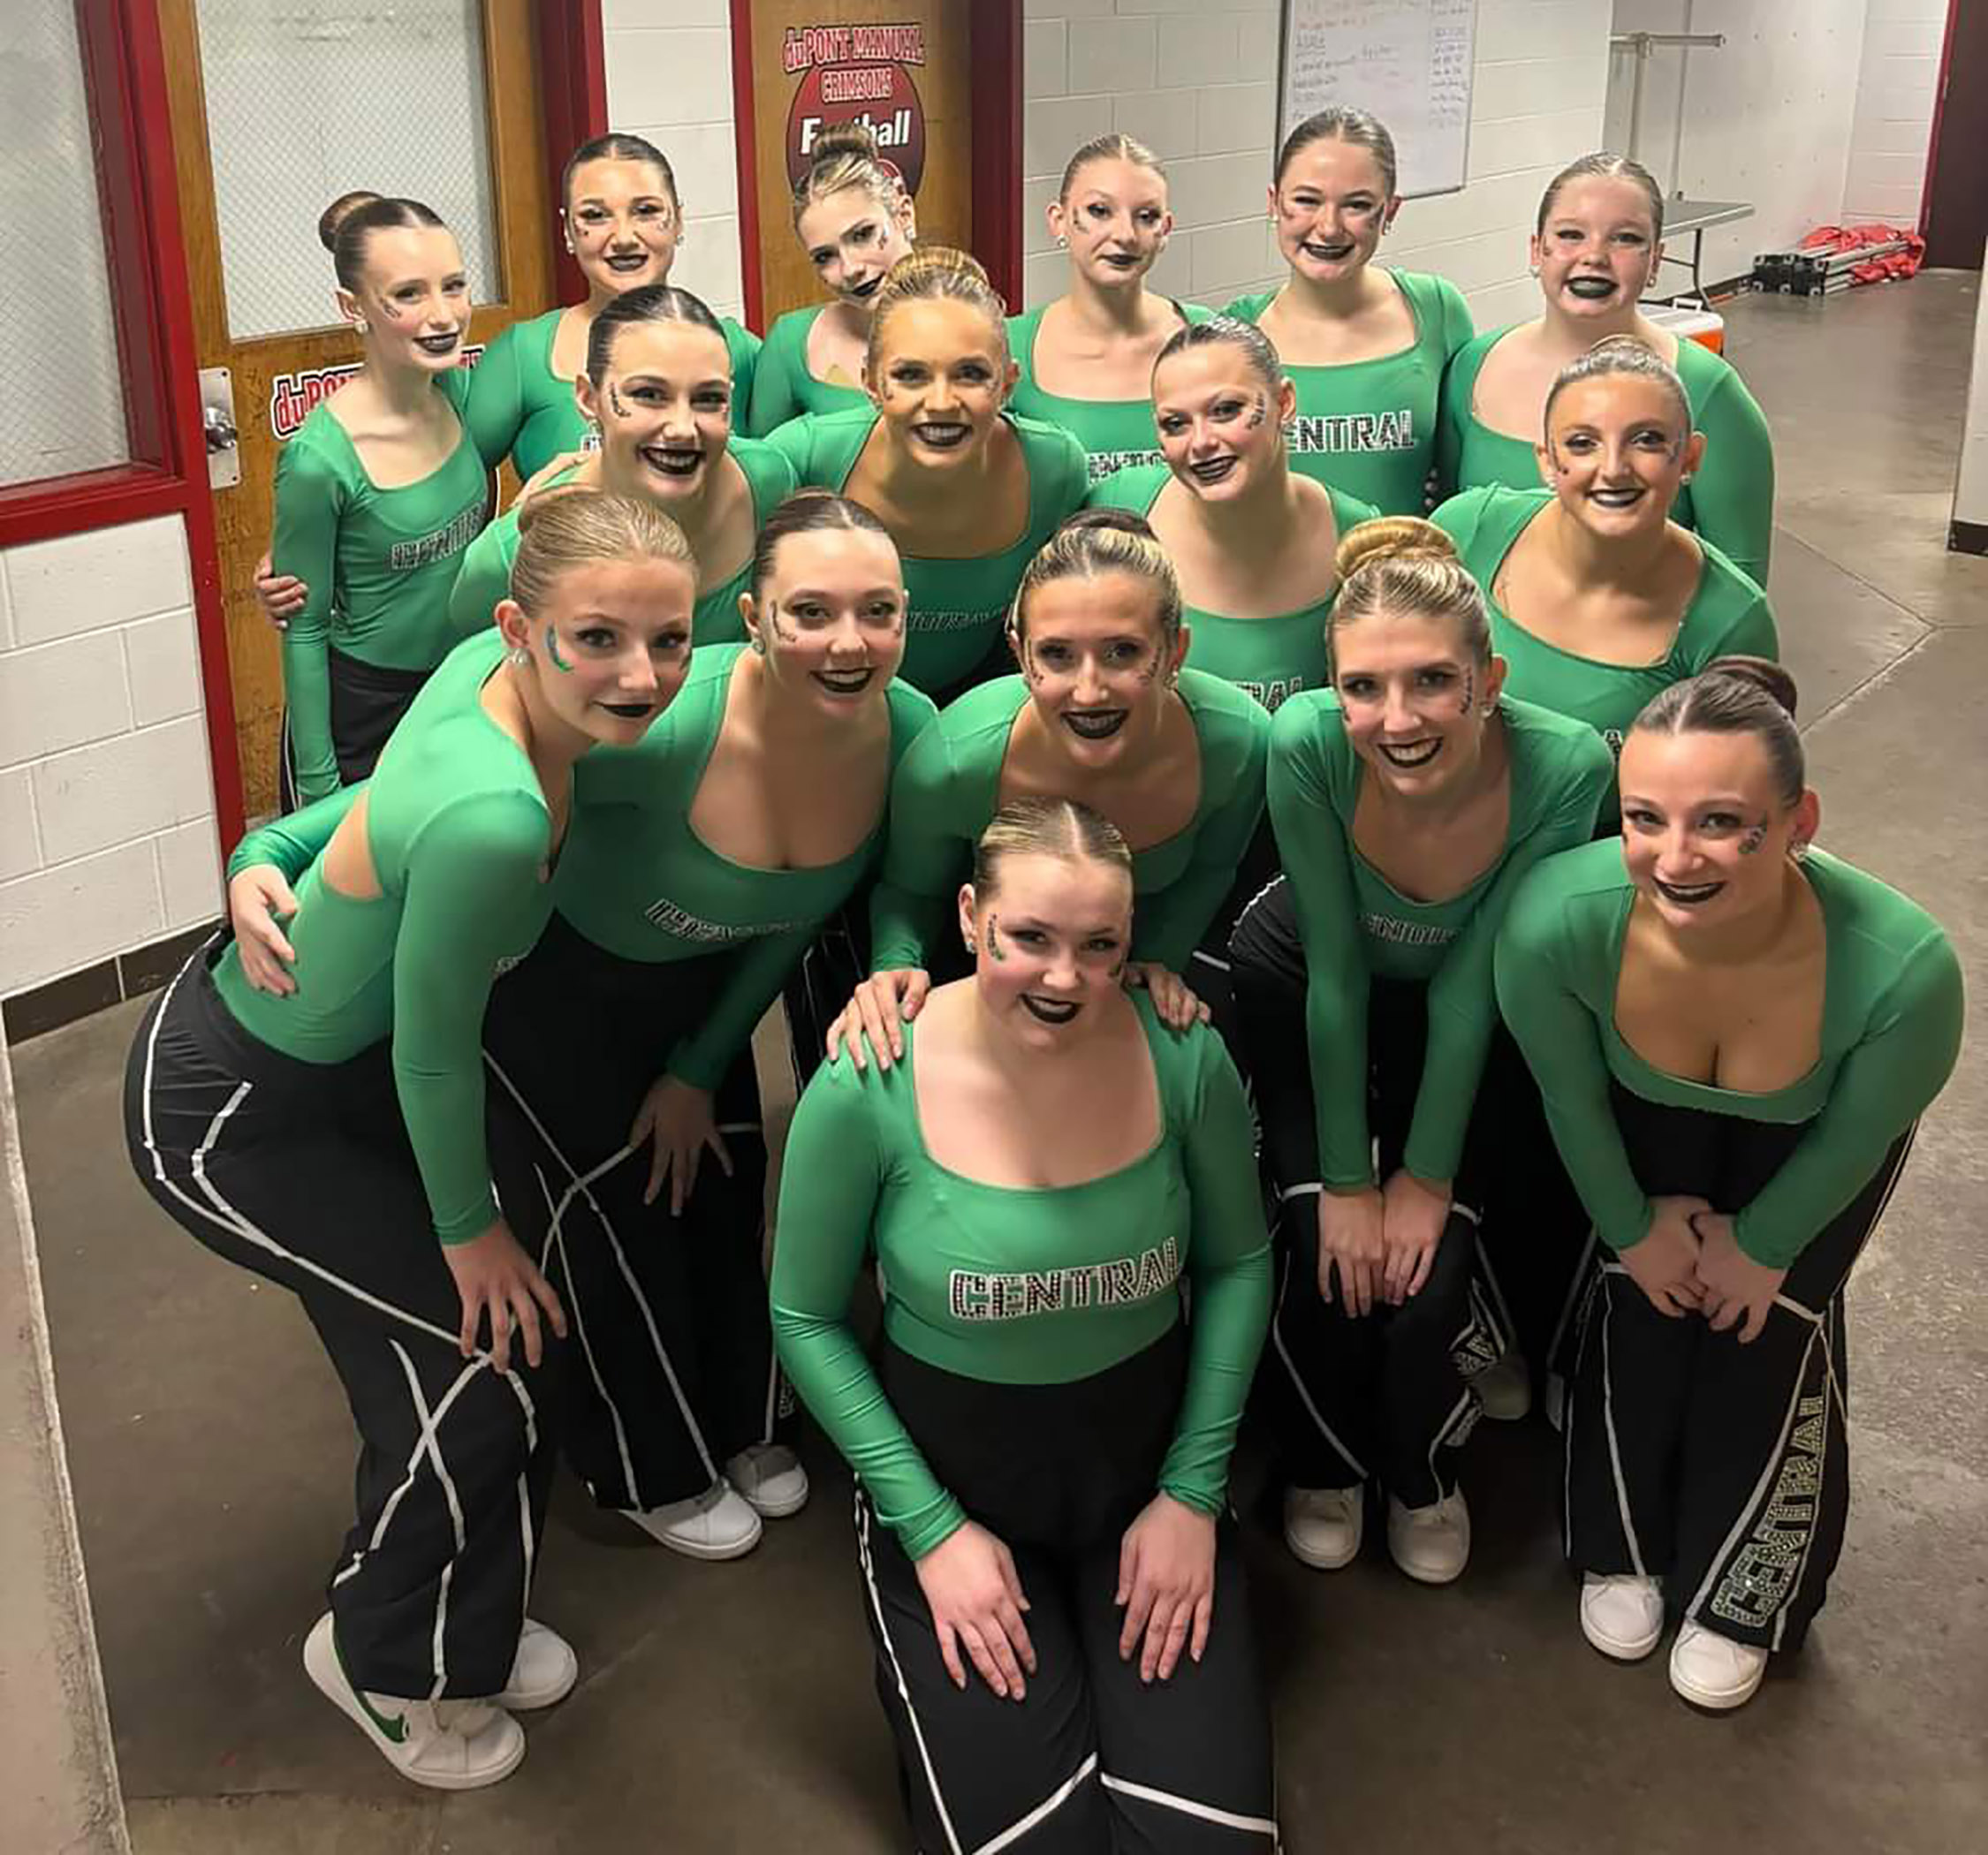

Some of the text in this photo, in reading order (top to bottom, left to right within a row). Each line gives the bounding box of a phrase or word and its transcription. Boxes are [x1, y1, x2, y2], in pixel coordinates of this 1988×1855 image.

[853, 26, 925, 64] MANUAL
[822, 68, 892, 102] CRIMSONS
[801, 110, 912, 155] Fball
[1284, 409, 1416, 454] ENTRAL
[950, 1237, 1179, 1320] CENTRAL
[1709, 1374, 1826, 1628] CENTRAL
